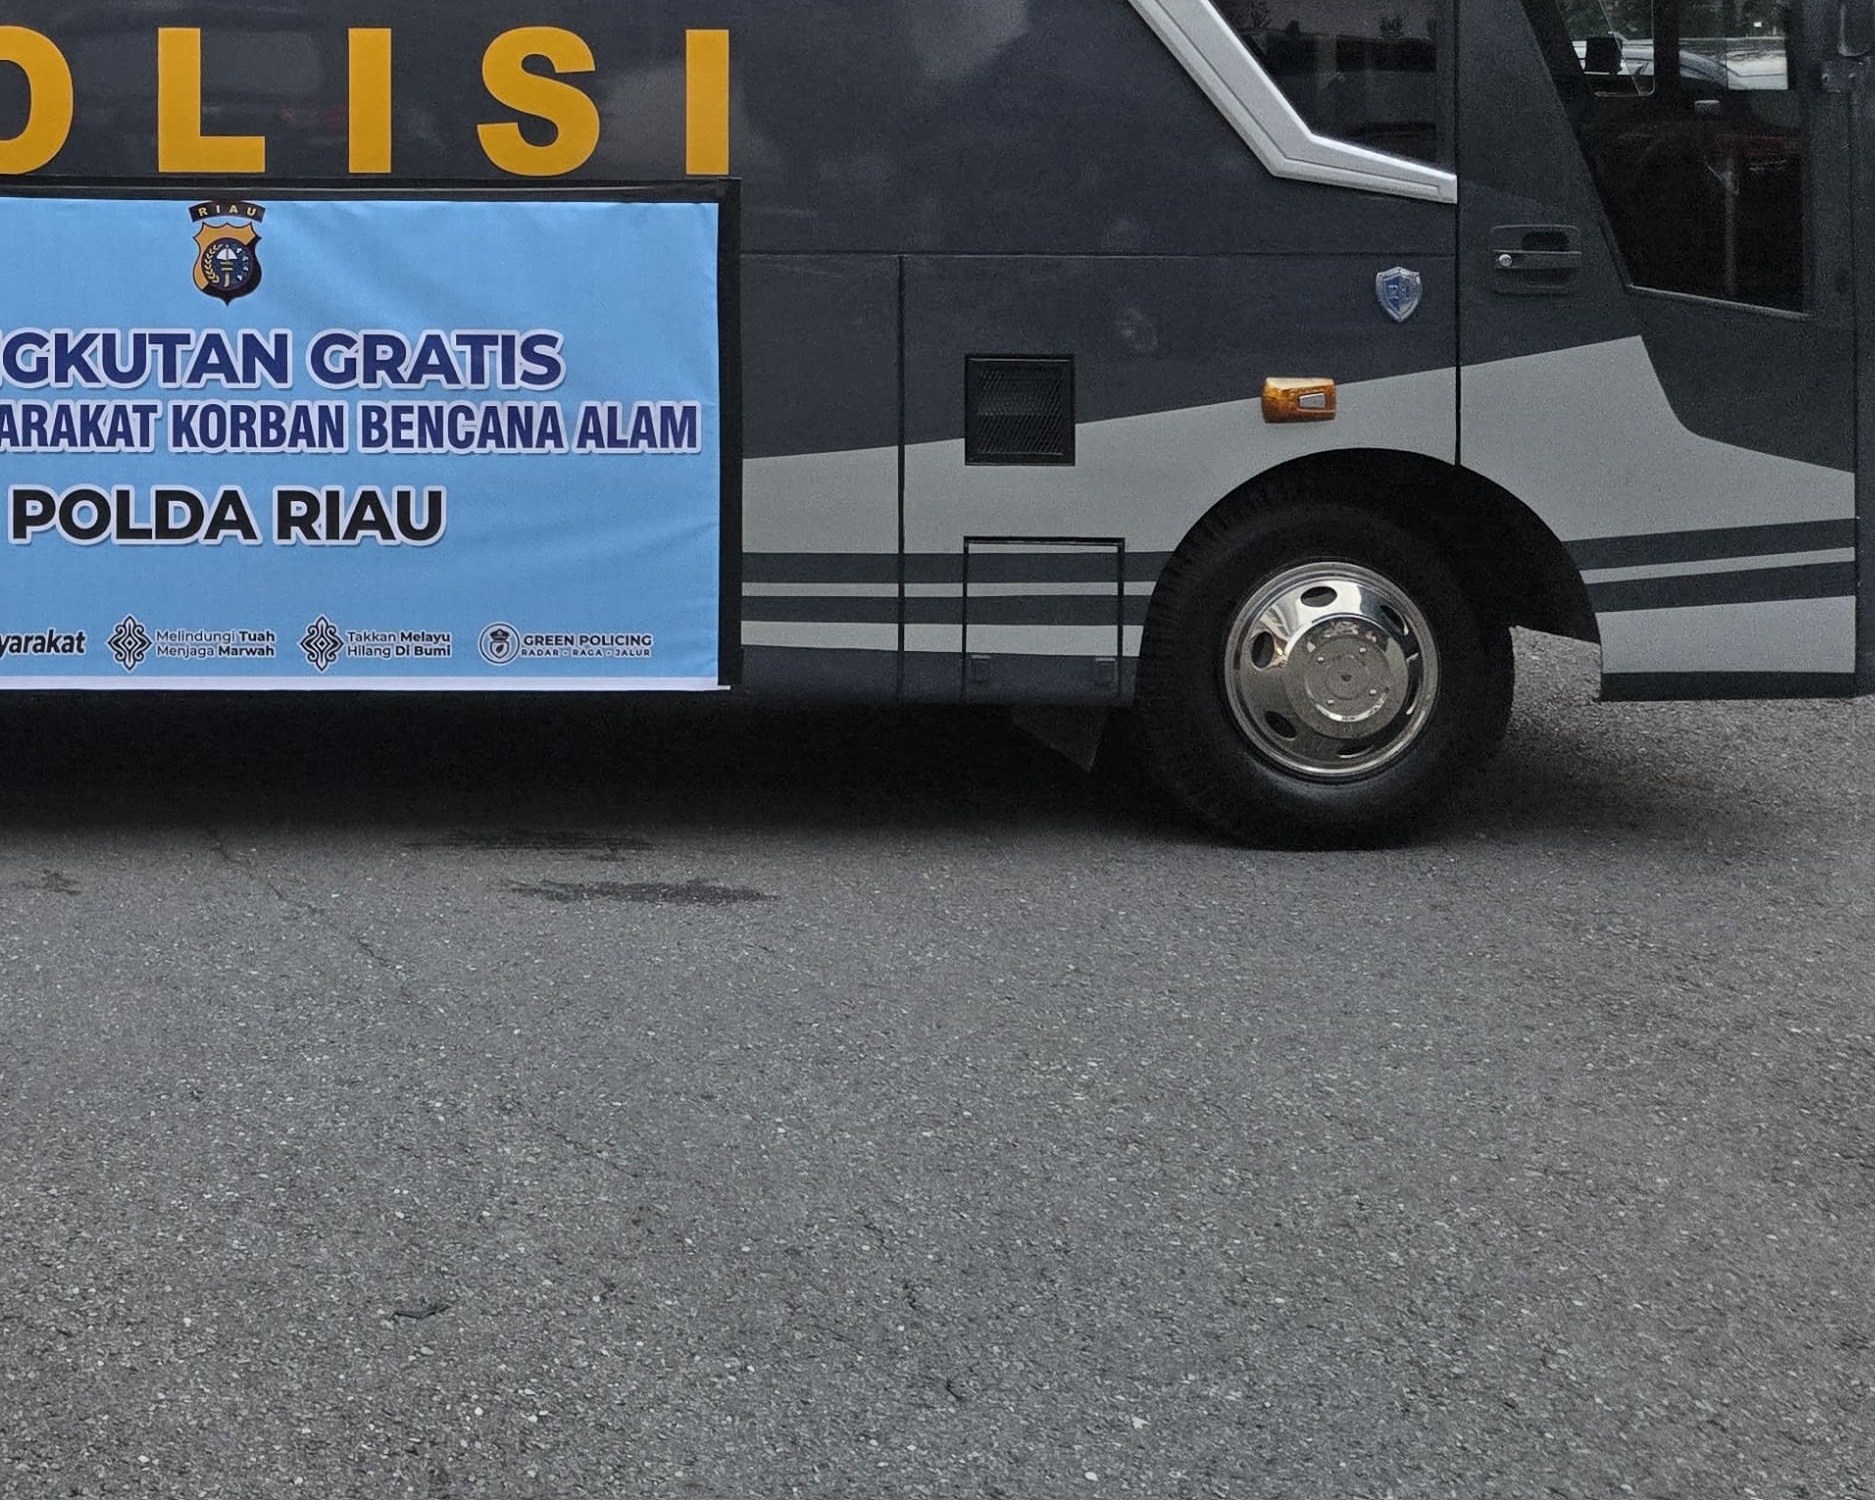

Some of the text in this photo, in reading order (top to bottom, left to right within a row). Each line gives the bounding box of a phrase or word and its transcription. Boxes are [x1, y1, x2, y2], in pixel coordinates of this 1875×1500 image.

[197, 204, 257, 217] RIAU
[310, 332, 566, 393] GRATIS
[172, 403, 350, 456] KORBAN
[361, 404, 569, 457] BENCANA
[576, 405, 701, 456] ALAM
[12, 488, 446, 549] POLDA RIAU
[156, 629, 275, 645] Melindungi Tuah
[347, 631, 451, 645] Takkan Melayu
[523, 634, 652, 647] GREEN POLICING
[156, 644, 275, 659] Menjaga Marwah
[347, 644, 451, 659] Hilang Di Bumi
[521, 648, 559, 657] RADAR
[614, 648, 651, 657] JALUR
